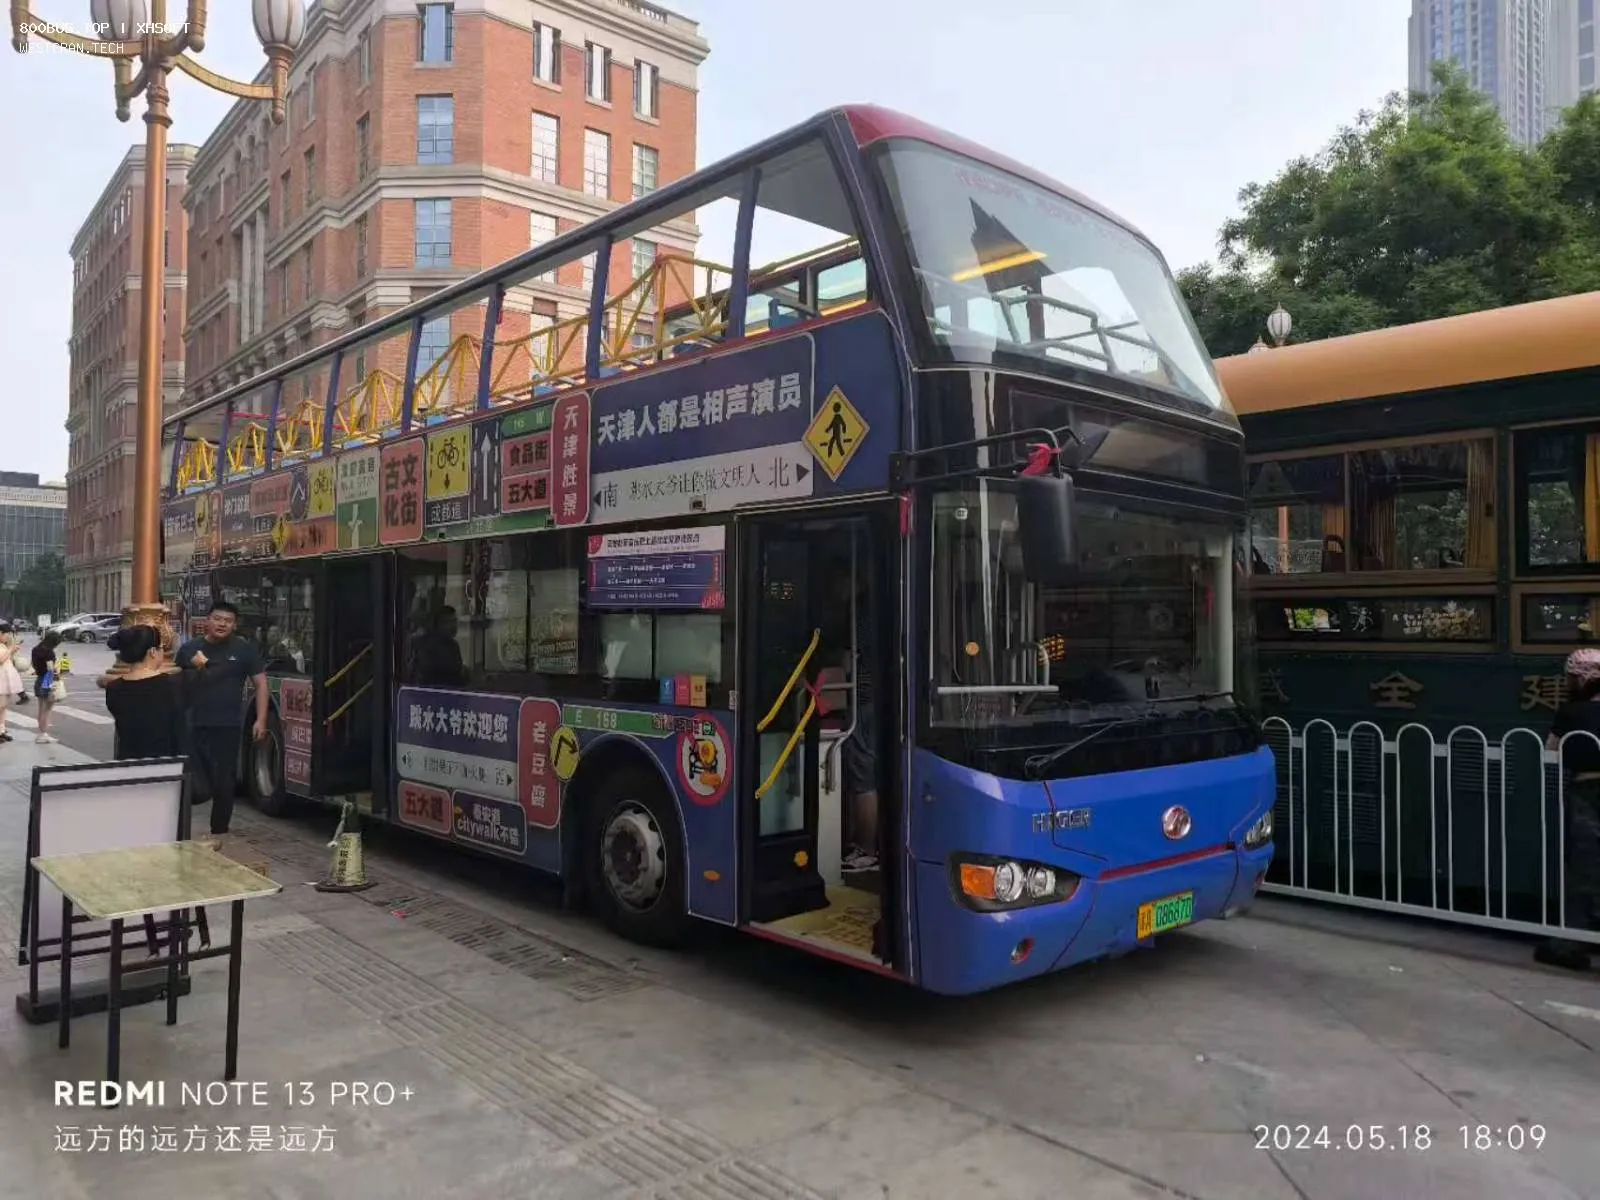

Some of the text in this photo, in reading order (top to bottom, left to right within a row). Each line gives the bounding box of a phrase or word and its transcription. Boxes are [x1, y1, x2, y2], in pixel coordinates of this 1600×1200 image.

[598, 372, 801, 445] 天津人都是相声演员
[769, 457, 789, 490] 北
[508, 478, 547, 504] 五大道
